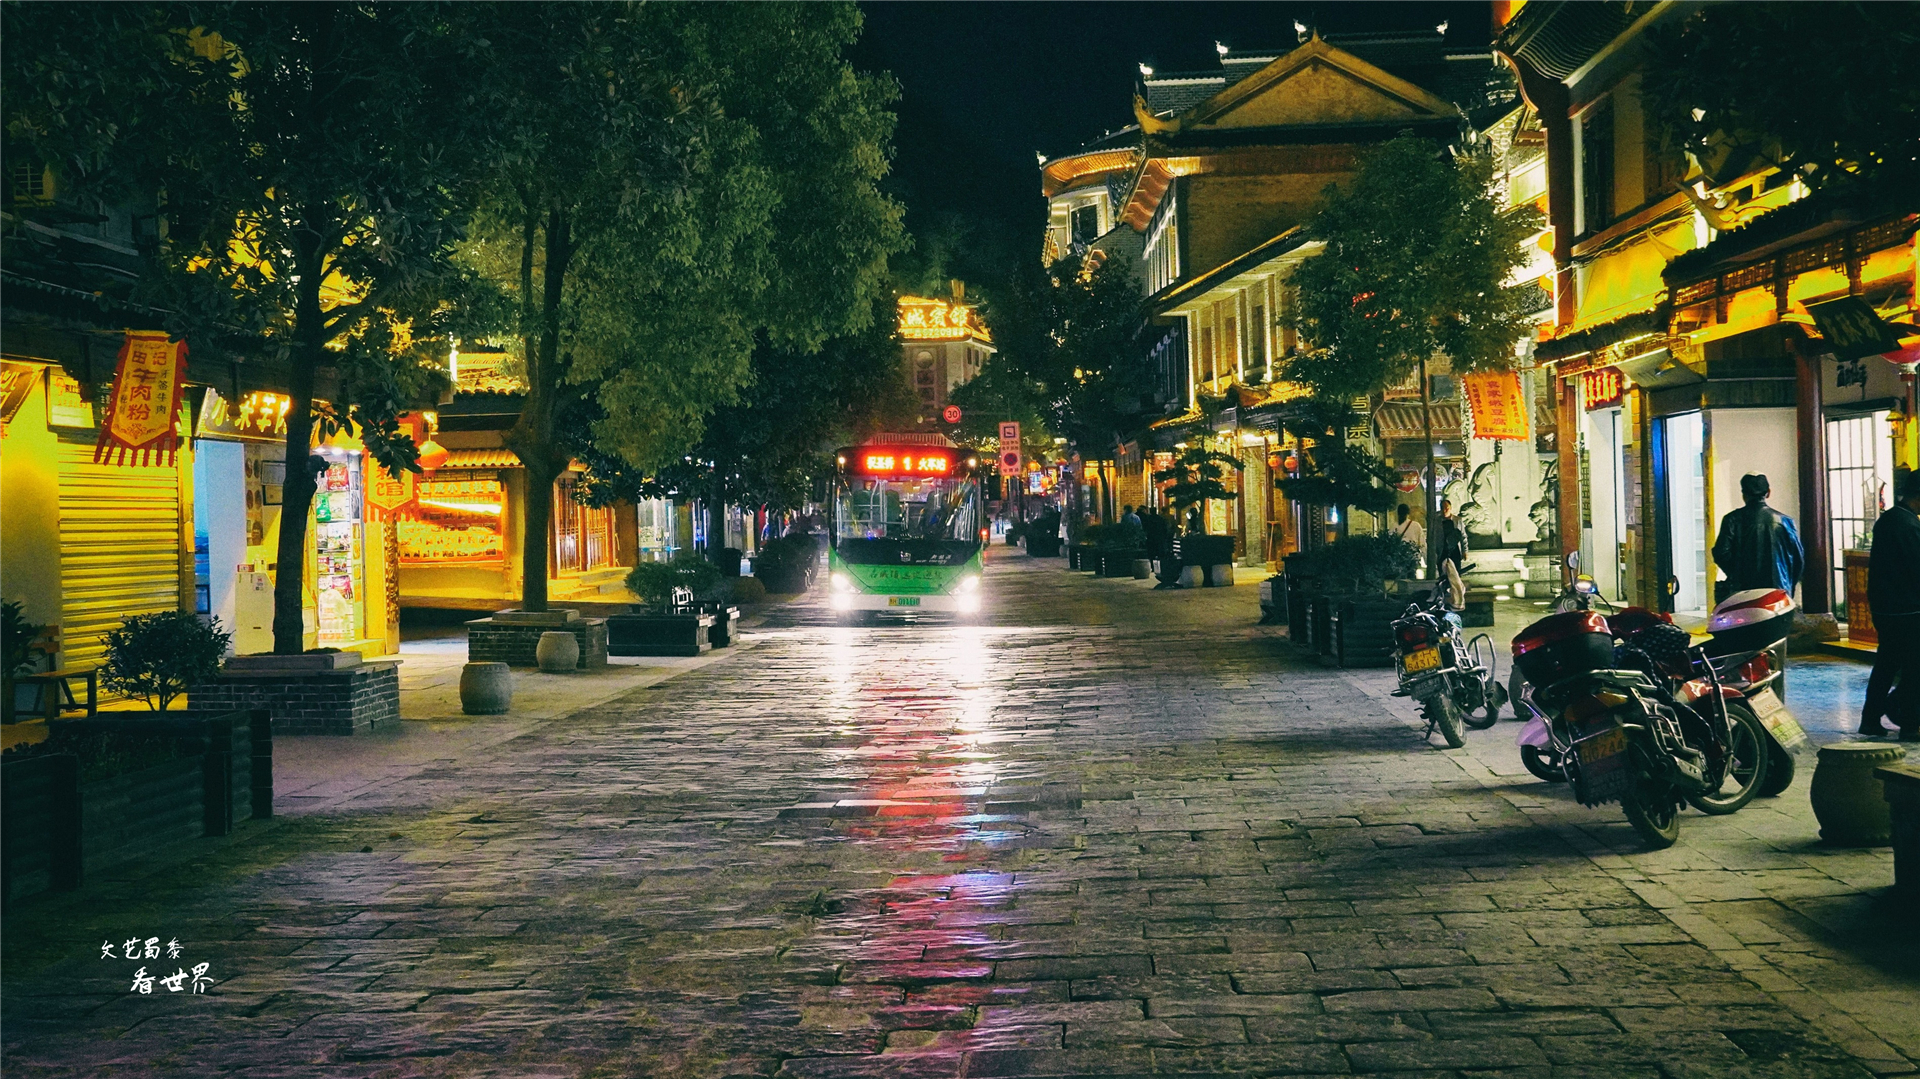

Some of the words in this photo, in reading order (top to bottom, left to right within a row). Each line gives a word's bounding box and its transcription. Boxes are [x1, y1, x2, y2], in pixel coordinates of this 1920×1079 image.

[132, 350, 167, 366] 田记
[127, 367, 159, 420] 牛肉粉
[155, 370, 171, 415] 牙签牛肉
[947, 410, 958, 419] 30
[903, 456, 912, 471] 1
